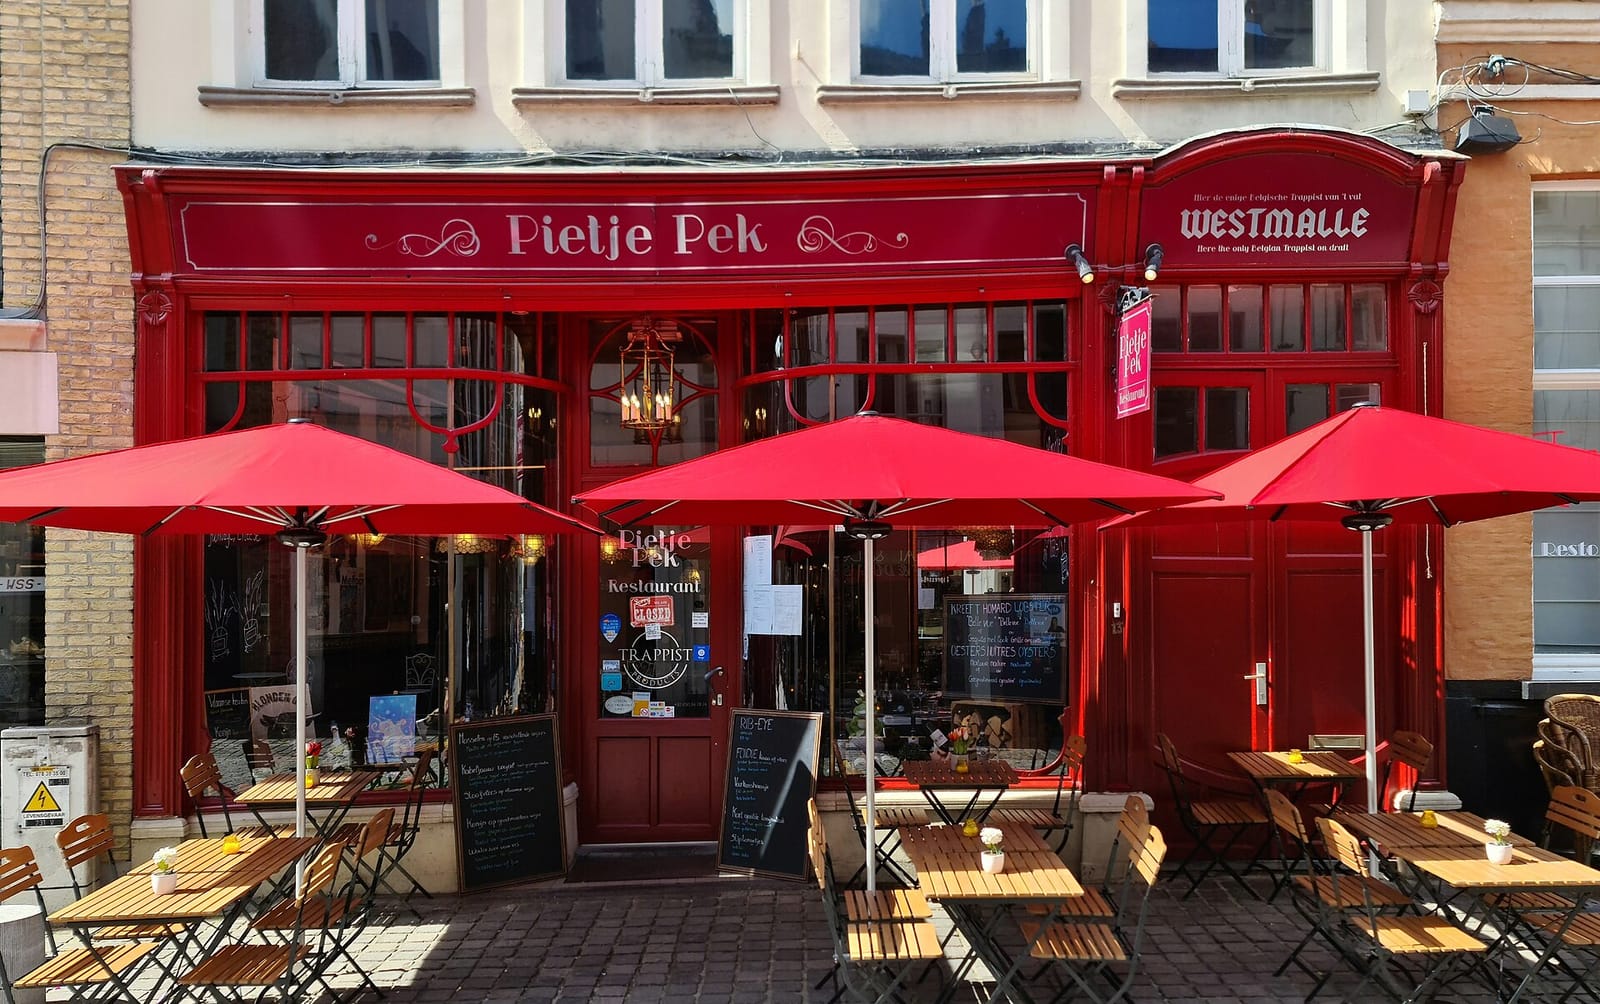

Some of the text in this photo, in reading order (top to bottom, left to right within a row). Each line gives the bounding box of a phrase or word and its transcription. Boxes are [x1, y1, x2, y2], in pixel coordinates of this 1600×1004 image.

[1291, 193, 1324, 203] Trappist
[1324, 193, 1340, 201] van
[1180, 207, 1370, 240] WESTMALLE
[506, 213, 768, 262] Pietje Pek
[1197, 245, 1217, 253] Here
[1217, 245, 1231, 253] the
[1232, 244, 1250, 254] only
[1251, 244, 1281, 254] Belgian
[1283, 244, 1316, 254] Trappist
[1120, 327, 1147, 360] Pietje
[1124, 354, 1142, 378] Pek
[617, 529, 692, 553] Pietje
[1540, 541, 1600, 557] Resto
[631, 546, 680, 568] Pek
[608, 579, 701, 594] Restaurant
[634, 607, 671, 621] CLOSED
[950, 603, 980, 616] KREEFT
[982, 602, 1012, 615] HOMARD
[618, 648, 693, 662] TRAPPIST
[1018, 645, 1057, 659] OYSTERS
[631, 671, 680, 687] PRODUCTS
[740, 717, 774, 731] RIB-EYE
